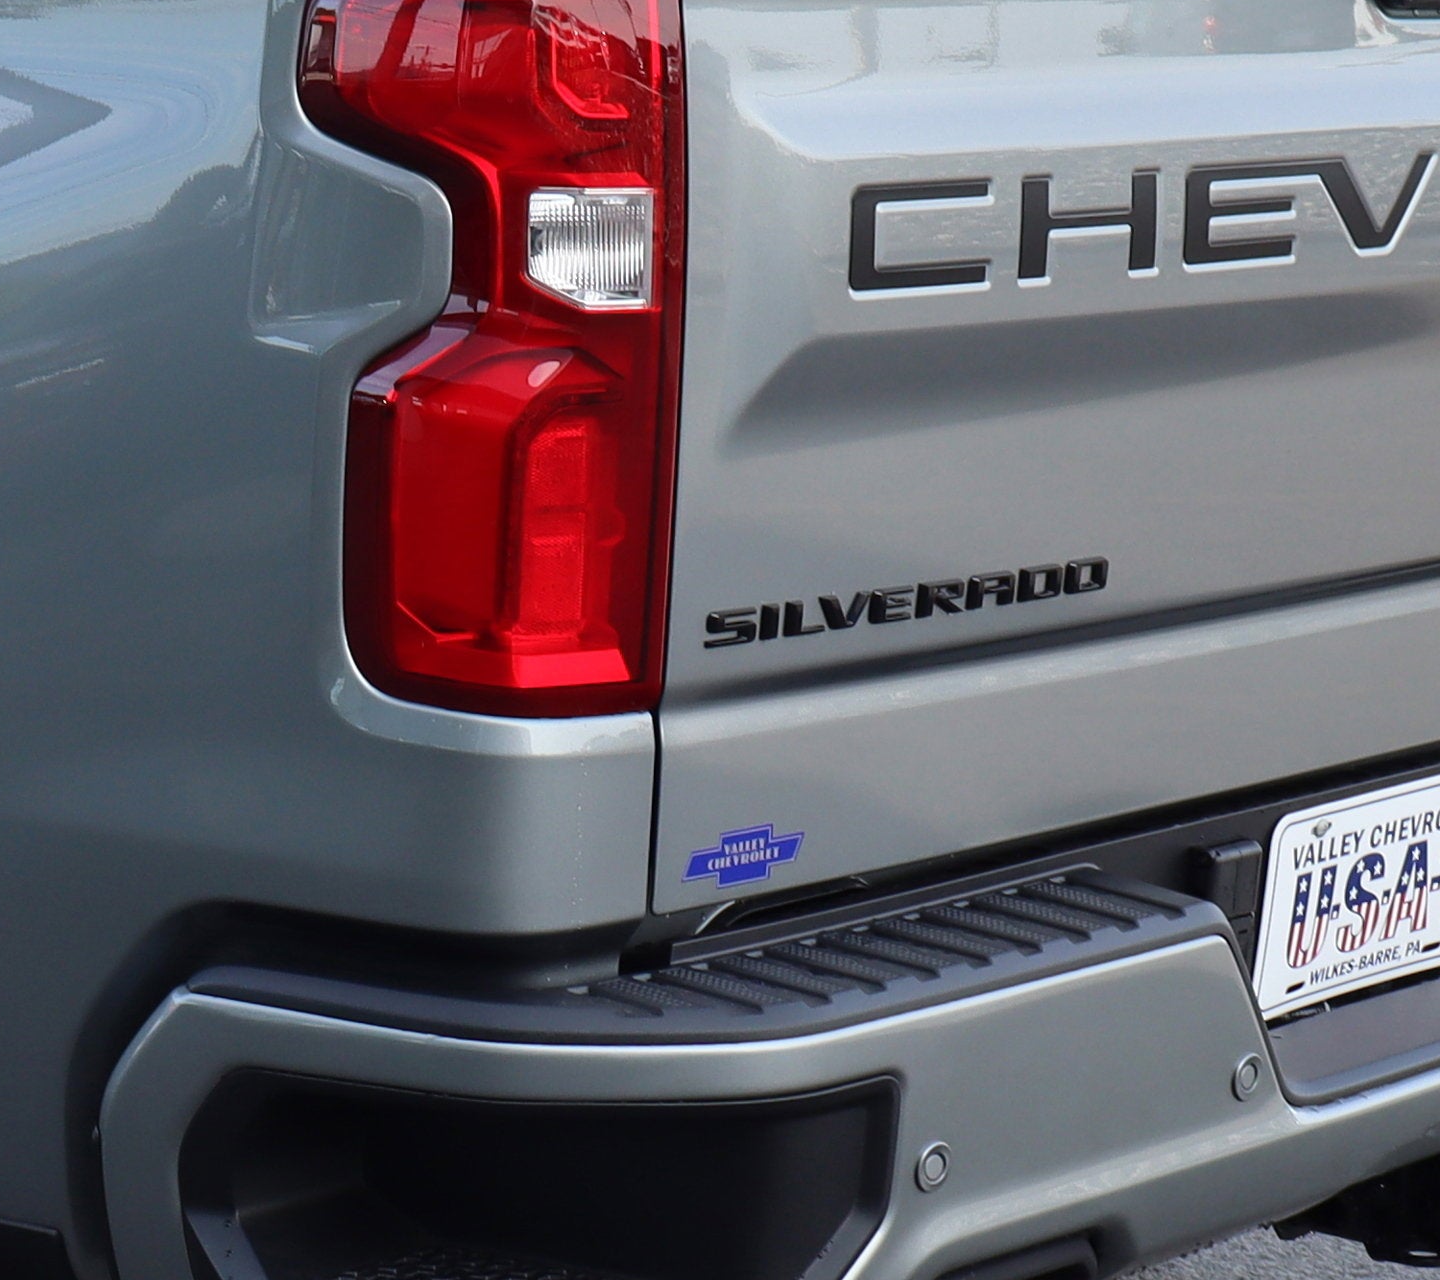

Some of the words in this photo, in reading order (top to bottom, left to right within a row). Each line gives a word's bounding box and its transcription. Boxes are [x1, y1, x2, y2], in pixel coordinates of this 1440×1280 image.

[703, 555, 1110, 650] SILVERADO
[707, 846, 780, 871] CHEVROLET
[723, 837, 767, 856] VALLEY
[1293, 829, 1366, 871] VALLEY
[1310, 946, 1402, 985] WILKES-BARRE,
[1405, 940, 1422, 957] PA
